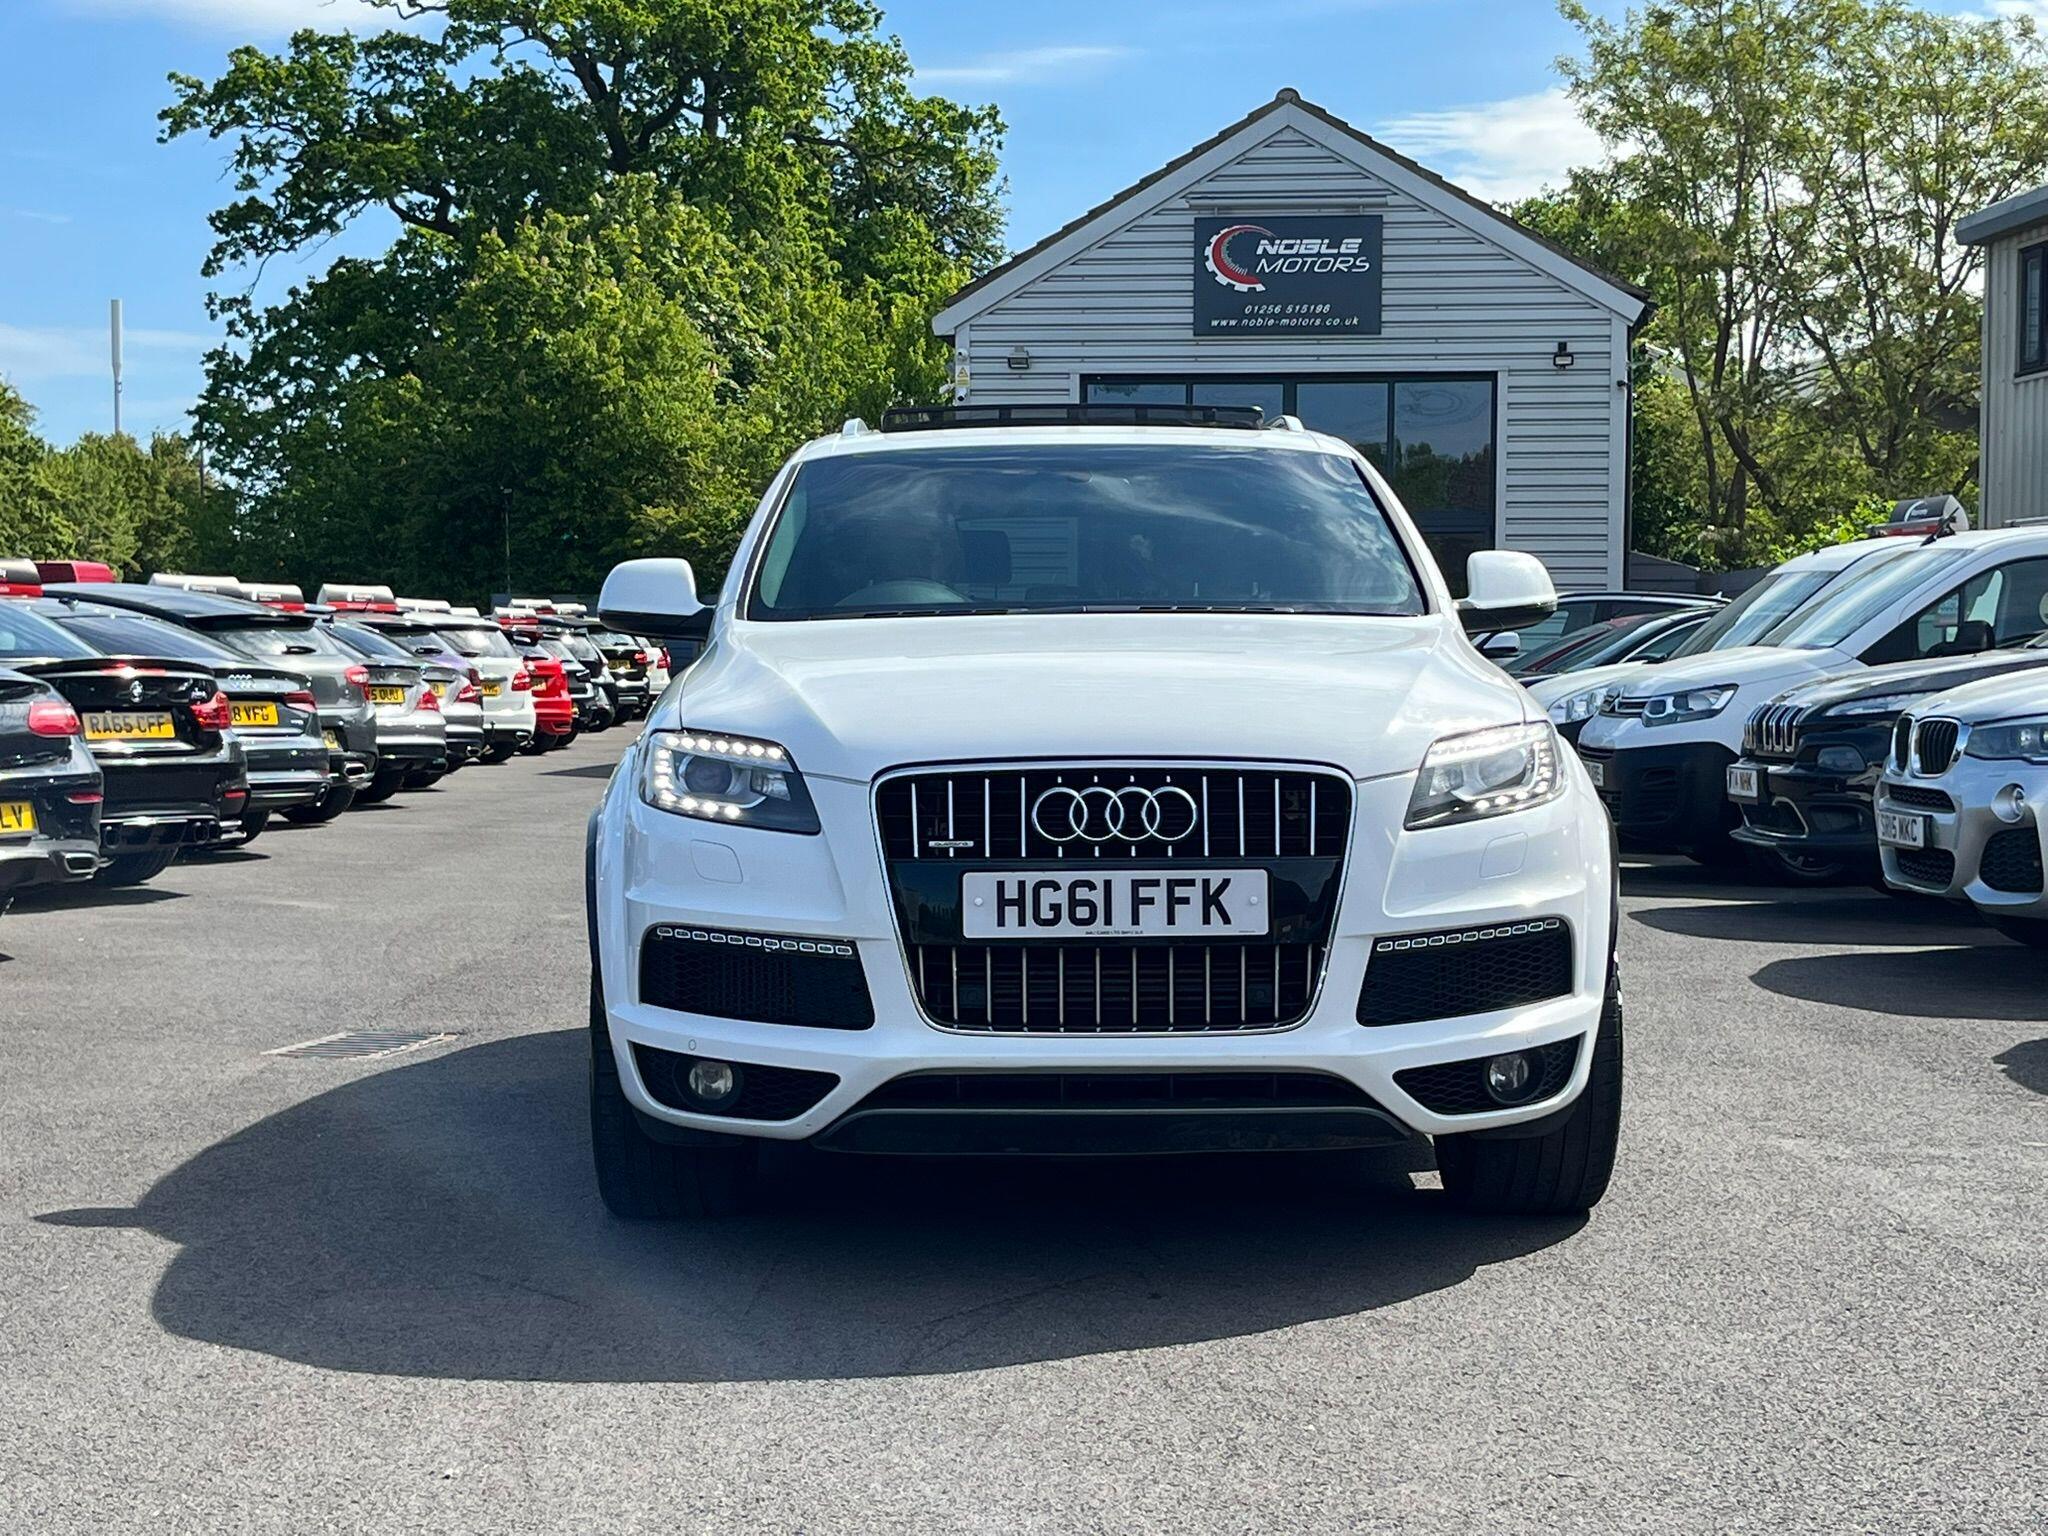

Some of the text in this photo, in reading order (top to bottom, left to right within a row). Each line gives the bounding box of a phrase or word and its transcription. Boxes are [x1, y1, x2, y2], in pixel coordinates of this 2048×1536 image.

[1256, 238, 1363, 255] NOBLE
[1255, 256, 1371, 273] MOTORS
[1244, 304, 1282, 315] 01256
[1210, 316, 1360, 328] www.noble-motors.co.uk
[89, 714, 166, 734] RA65 CFF
[996, 877, 1233, 928] HG61 FFK
